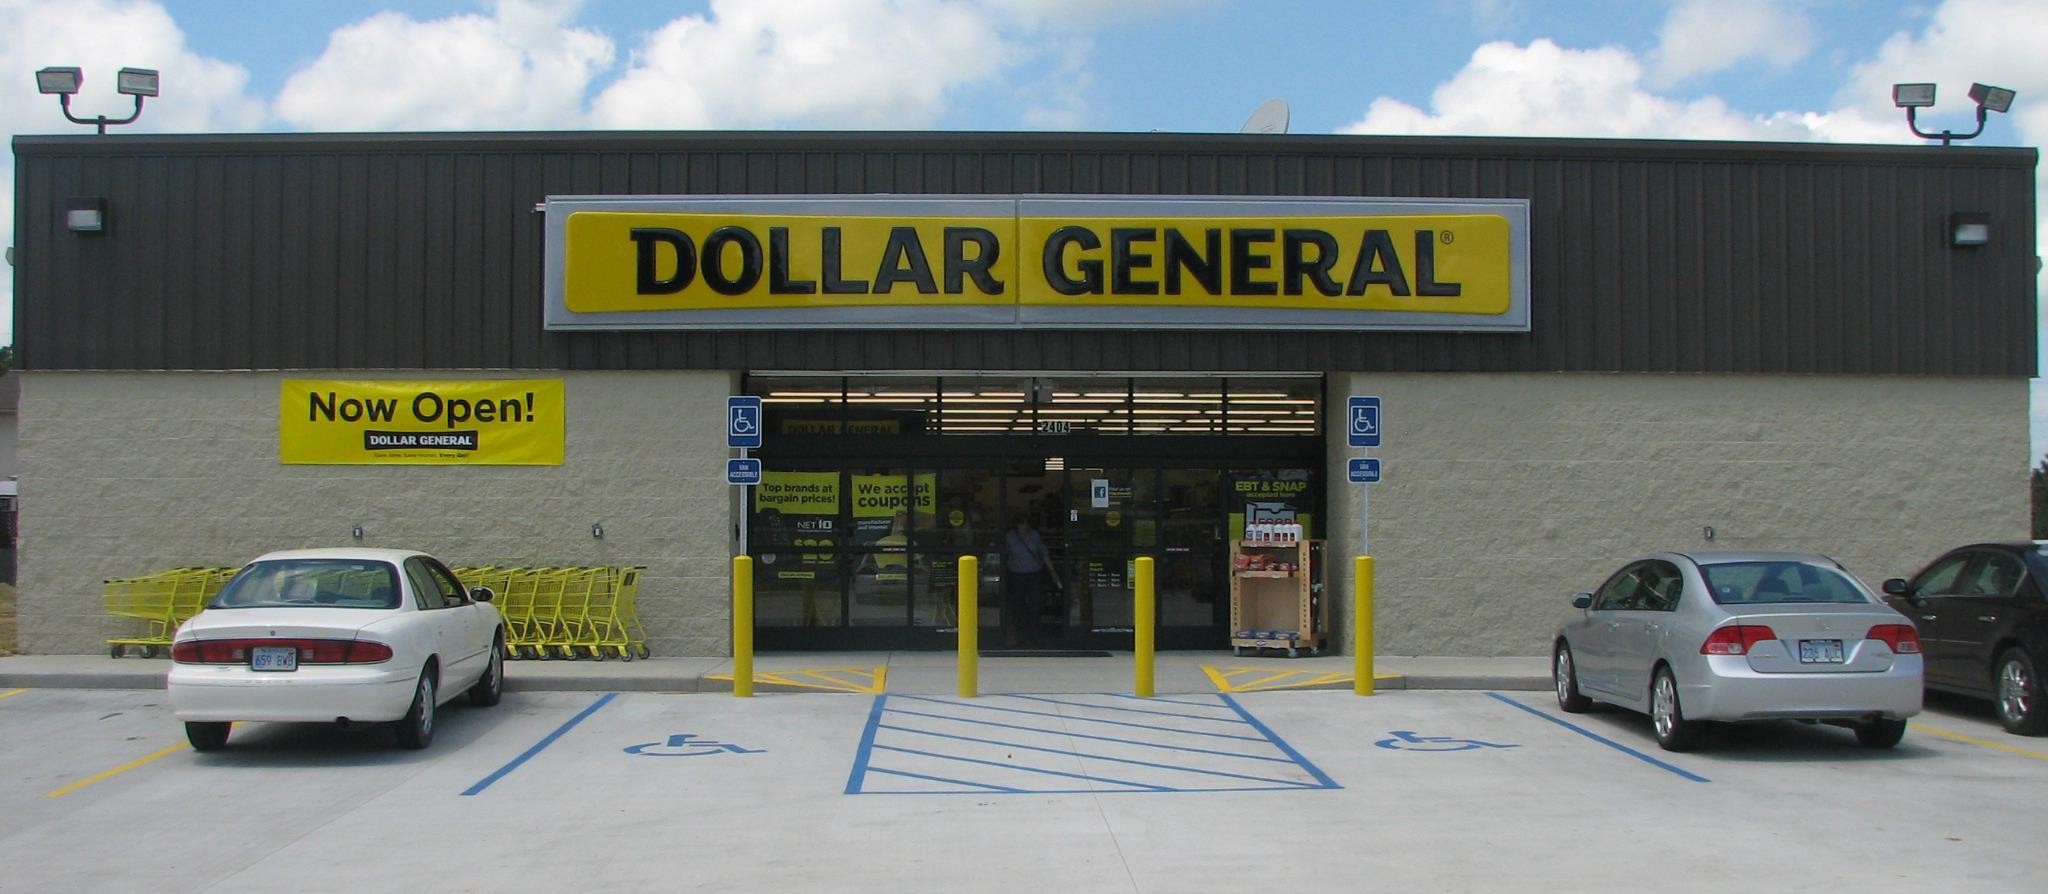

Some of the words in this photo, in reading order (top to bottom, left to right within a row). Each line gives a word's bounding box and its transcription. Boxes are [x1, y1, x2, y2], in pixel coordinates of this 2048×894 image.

[630, 226, 1006, 296] DOLLAR
[309, 392, 398, 422] Now
[412, 391, 534, 429] Open!
[1041, 420, 1071, 432] 2404
[370, 435, 417, 446] DOLLAR
[419, 435, 473, 446] GENERAL
[763, 483, 782, 493] Top
[784, 483, 820, 492] brands
[822, 484, 833, 492] at
[858, 484, 881, 494] We
[884, 483, 930, 495] accpt
[1235, 481, 1259, 491] EBT
[1261, 481, 1270, 491] &
[1272, 481, 1307, 491] SNAP
[759, 494, 799, 504] bargain
[801, 494, 836, 504] prices!
